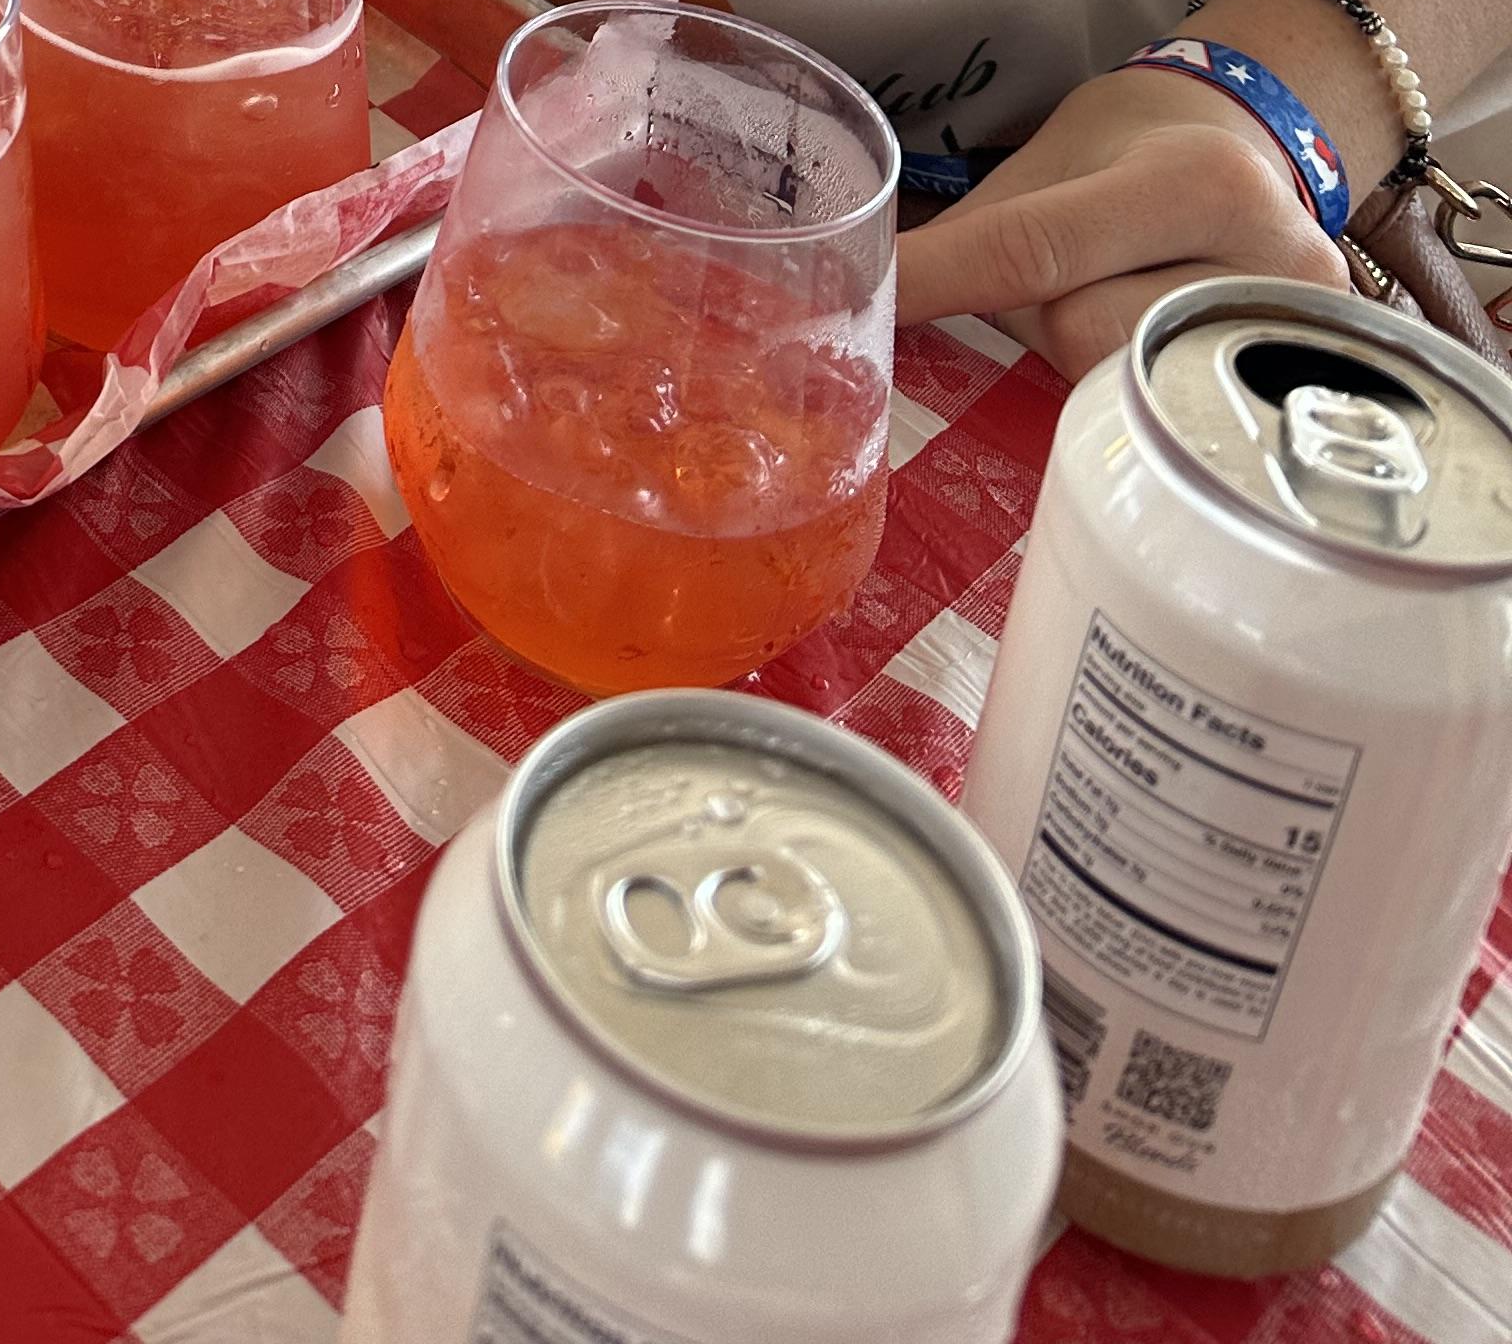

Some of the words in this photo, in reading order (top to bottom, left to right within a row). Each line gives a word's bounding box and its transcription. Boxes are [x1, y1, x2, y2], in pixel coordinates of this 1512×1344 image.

[1091, 625, 1186, 713] Nutrition
[1191, 700, 1266, 751] Facts
[1070, 702, 1159, 787] Calories
[1284, 825, 1322, 854] 15
